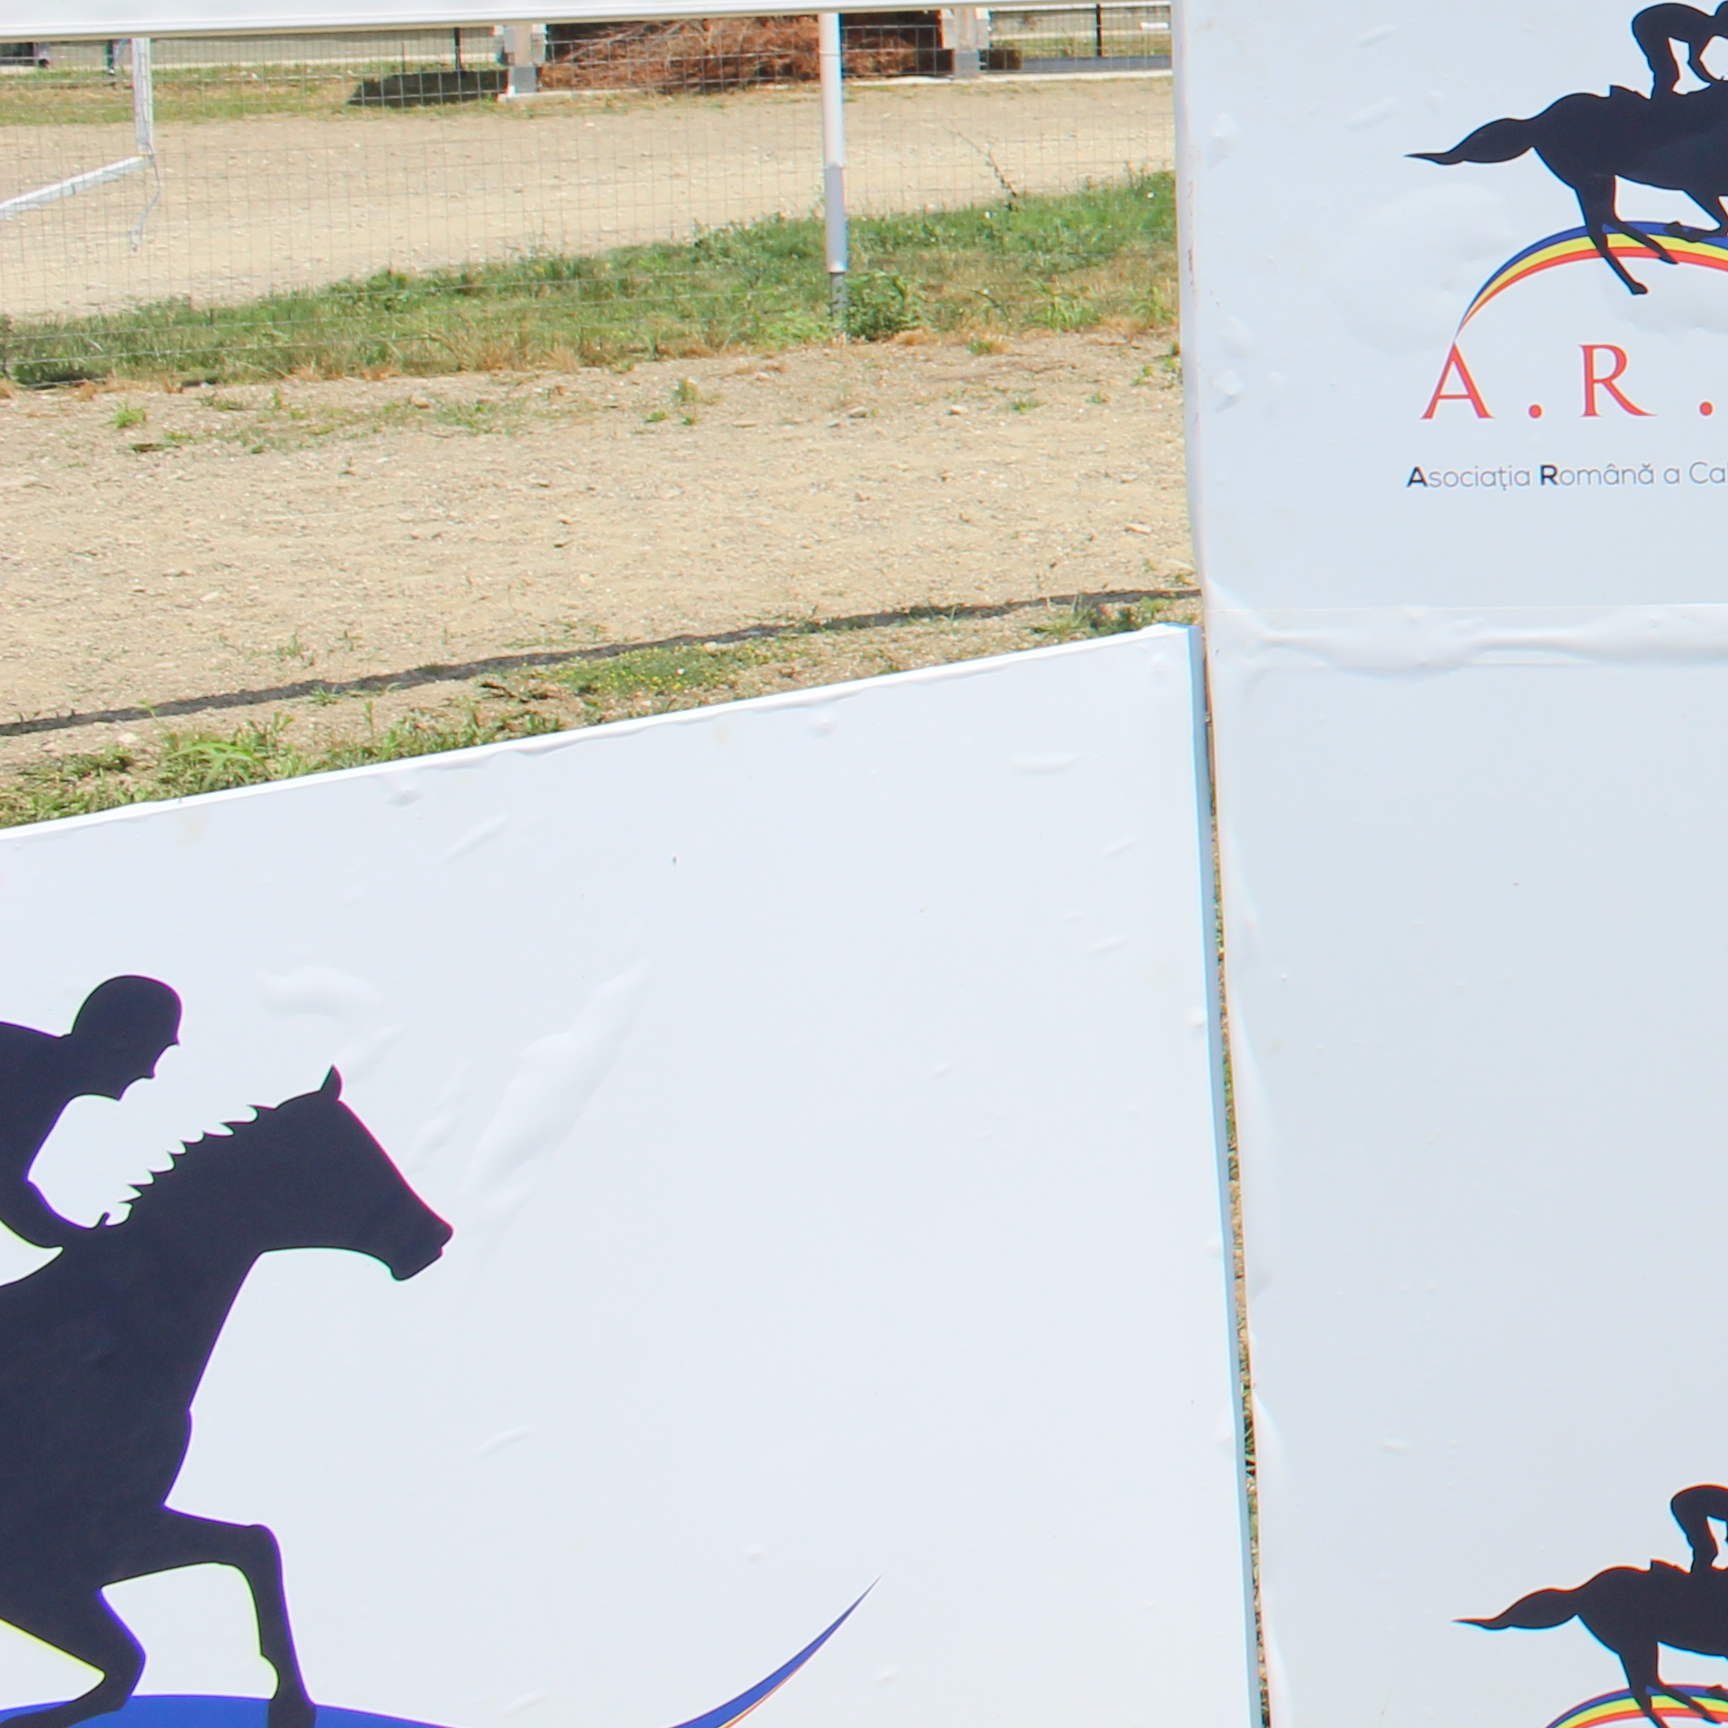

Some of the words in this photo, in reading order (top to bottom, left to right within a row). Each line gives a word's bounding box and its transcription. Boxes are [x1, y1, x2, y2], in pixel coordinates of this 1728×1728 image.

[1405, 465, 1531, 491] Asociația
[1539, 462, 1655, 486] Română
[1664, 467, 1681, 484] a
